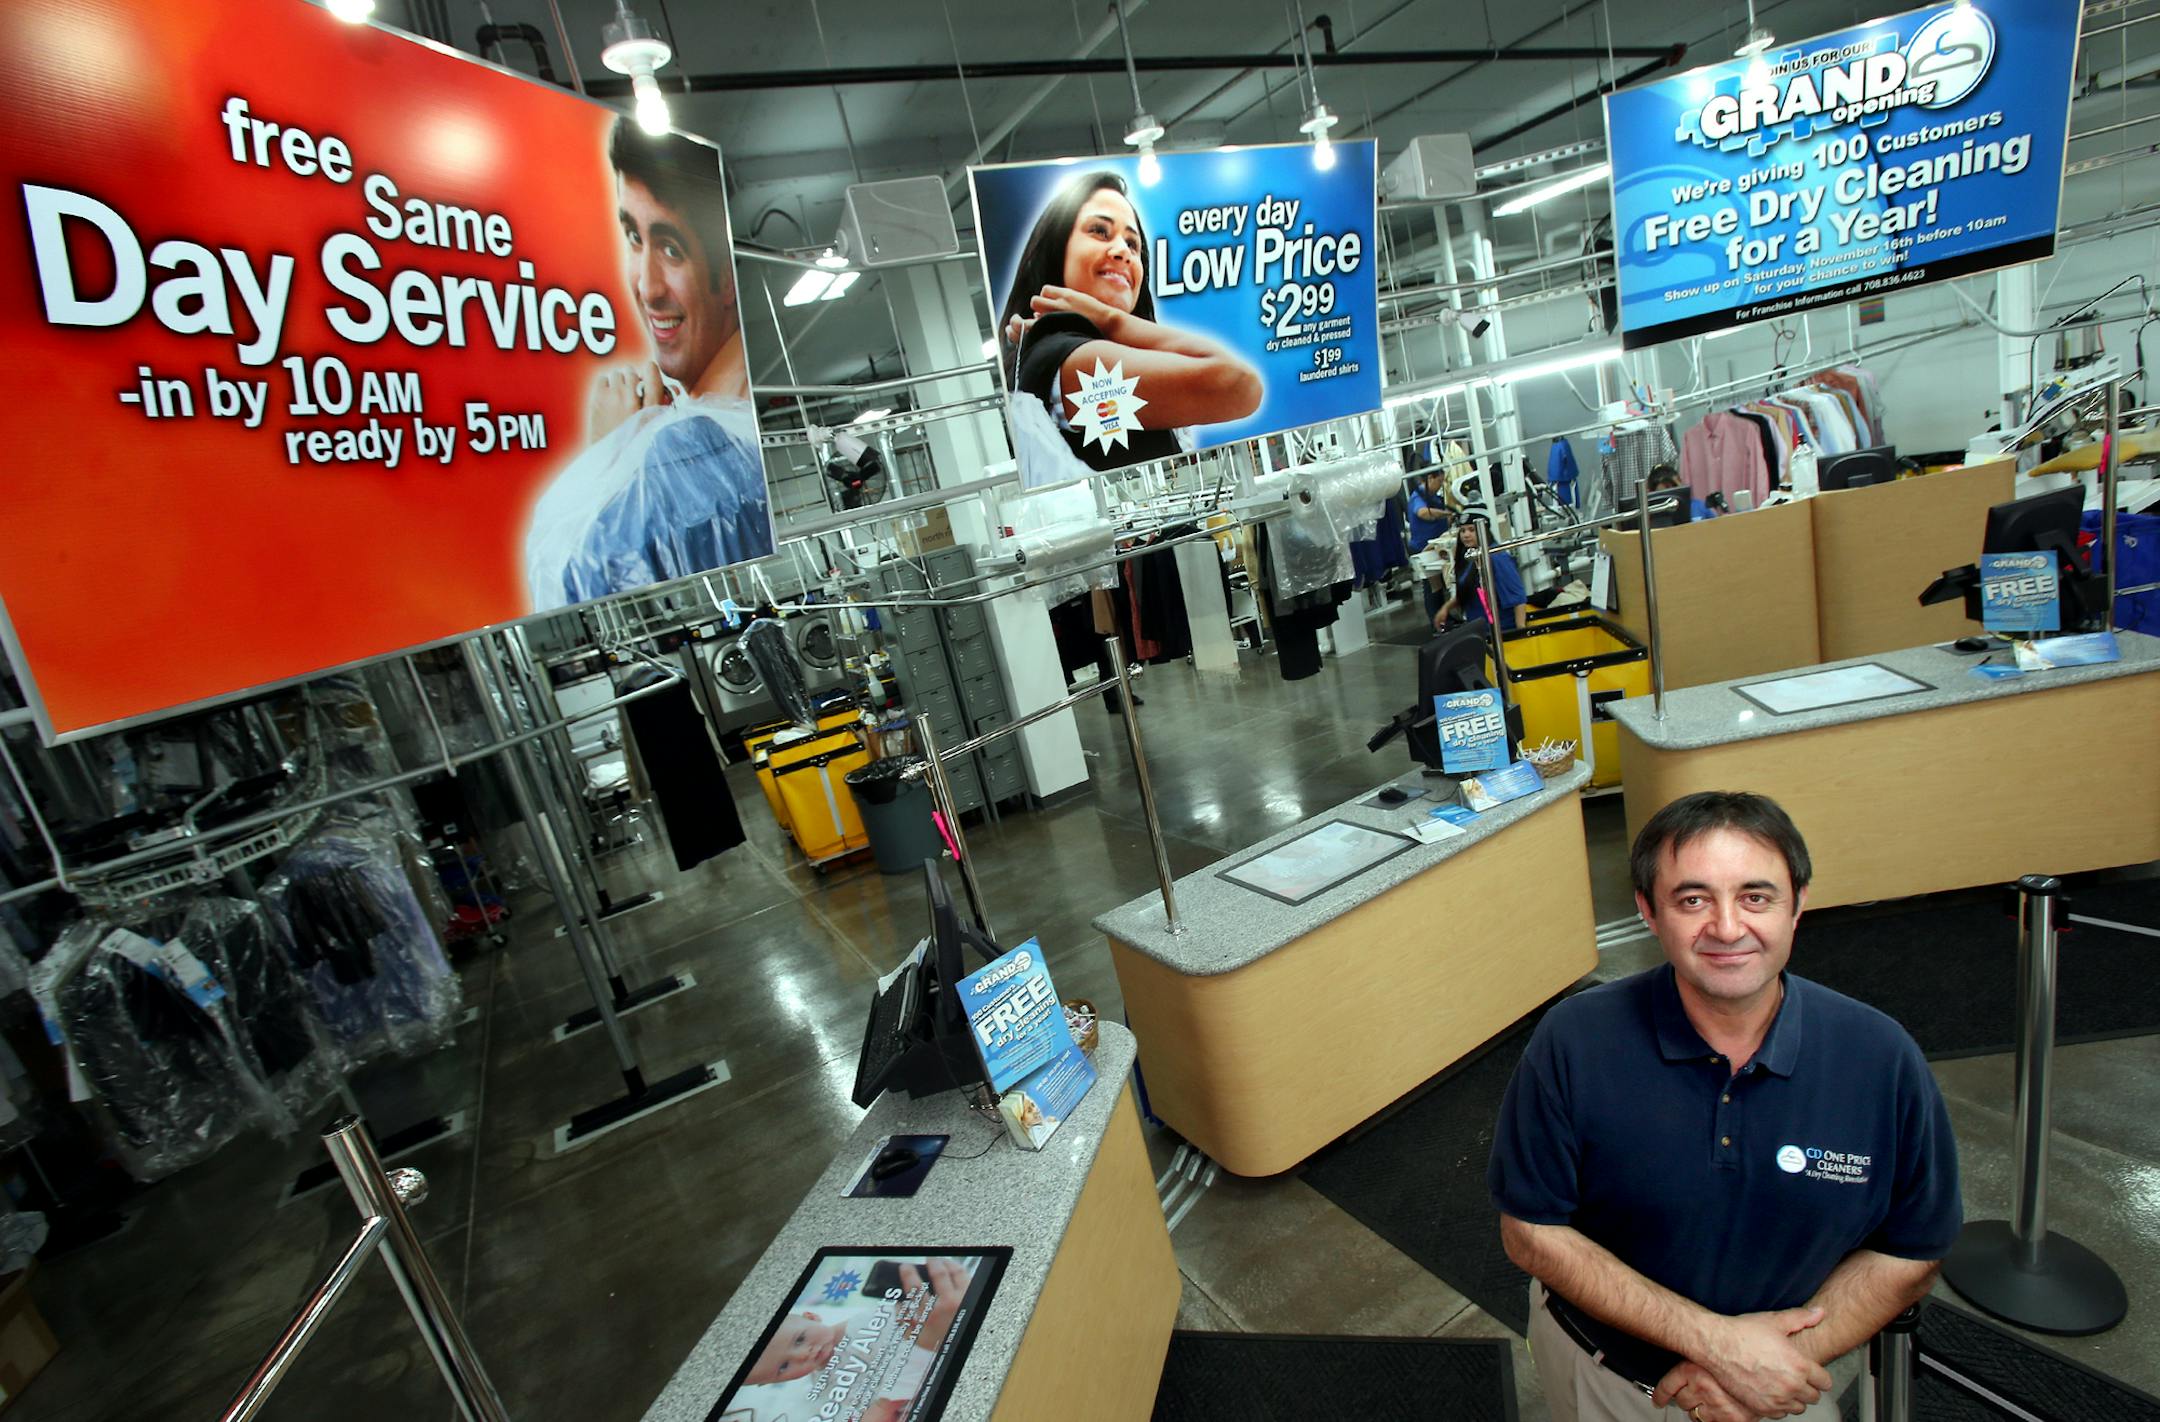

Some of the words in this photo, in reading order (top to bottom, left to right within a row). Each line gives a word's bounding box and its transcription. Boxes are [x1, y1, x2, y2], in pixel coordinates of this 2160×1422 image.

[1791, 58, 1809, 70] US
[1812, 50, 1839, 65] FOR
[1700, 54, 1907, 140] GRAND
[1832, 81, 1937, 124] opening
[220, 97, 353, 184] free
[1672, 179, 1732, 205] We're
[1738, 161, 1804, 193] giving
[1812, 132, 1868, 169] 100
[1876, 111, 2002, 153] Customers
[1645, 207, 1738, 252] Free
[1750, 184, 1826, 228] Dry
[1834, 133, 2032, 206] Cleaning
[364, 175, 513, 256] Same
[1178, 205, 1248, 237] every
[1256, 195, 1300, 228] day
[1725, 232, 1786, 270] for
[1794, 226, 1820, 255] a
[1829, 188, 1938, 246] Year!
[23, 184, 294, 366] Day
[321, 233, 617, 354] Service
[1157, 236, 1245, 298] Low
[1255, 223, 1362, 284] Price
[1664, 287, 1700, 302] Show
[1703, 283, 1720, 294] up
[1723, 278, 1740, 288] on
[1744, 262, 1806, 284] Saturday,
[1810, 245, 1879, 269] November
[1883, 236, 1914, 251] 16th
[1917, 225, 1963, 243] before
[1967, 215, 2007, 232] 10am
[1754, 284, 1773, 295] for
[1776, 277, 1804, 293] your
[1808, 264, 1859, 282] chance
[1863, 261, 1877, 270] to
[1880, 250, 1909, 265] win!
[1736, 309, 1750, 320] For
[1752, 300, 1793, 317] Franchise
[1795, 287, 1844, 306] Information
[1846, 283, 1862, 295] call
[1266, 340, 1280, 352] dry
[1281, 333, 1312, 349] cleaned
[1313, 332, 1320, 342] &
[1321, 327, 1351, 343] pressed
[1302, 322, 1318, 333] any
[1319, 316, 1351, 331] garment
[120, 367, 193, 418] -in
[206, 369, 267, 427] by
[283, 357, 354, 416] 10
[361, 371, 422, 414] AM
[1092, 377, 1112, 390] NOW
[1299, 366, 1337, 382] laundered
[1338, 362, 1359, 375] shirts
[1082, 386, 1127, 405] ACCEPTING
[285, 418, 402, 468] ready
[414, 418, 456, 463] by
[466, 402, 495, 452] 5
[500, 414, 546, 450] PM
[1103, 421, 1119, 431] VISA
[1985, 575, 2055, 600] FREE
[1441, 713, 1503, 742] FREE
[975, 963, 1017, 993] GRAND
[976, 974, 1053, 1047] FREE
[997, 1030, 1014, 1048] dry
[1015, 996, 1056, 1032] cleaning
[1806, 1147, 1823, 1159] CD
[1824, 1150, 1845, 1163] ONE
[1847, 1153, 1871, 1166] PRICE
[1817, 1160, 1863, 1175] CLEANERS
[850, 1287, 903, 1354] Alerts
[911, 1323, 923, 1335] be
[807, 1354, 840, 1401] Sign-up
[833, 1335, 850, 1353] for
